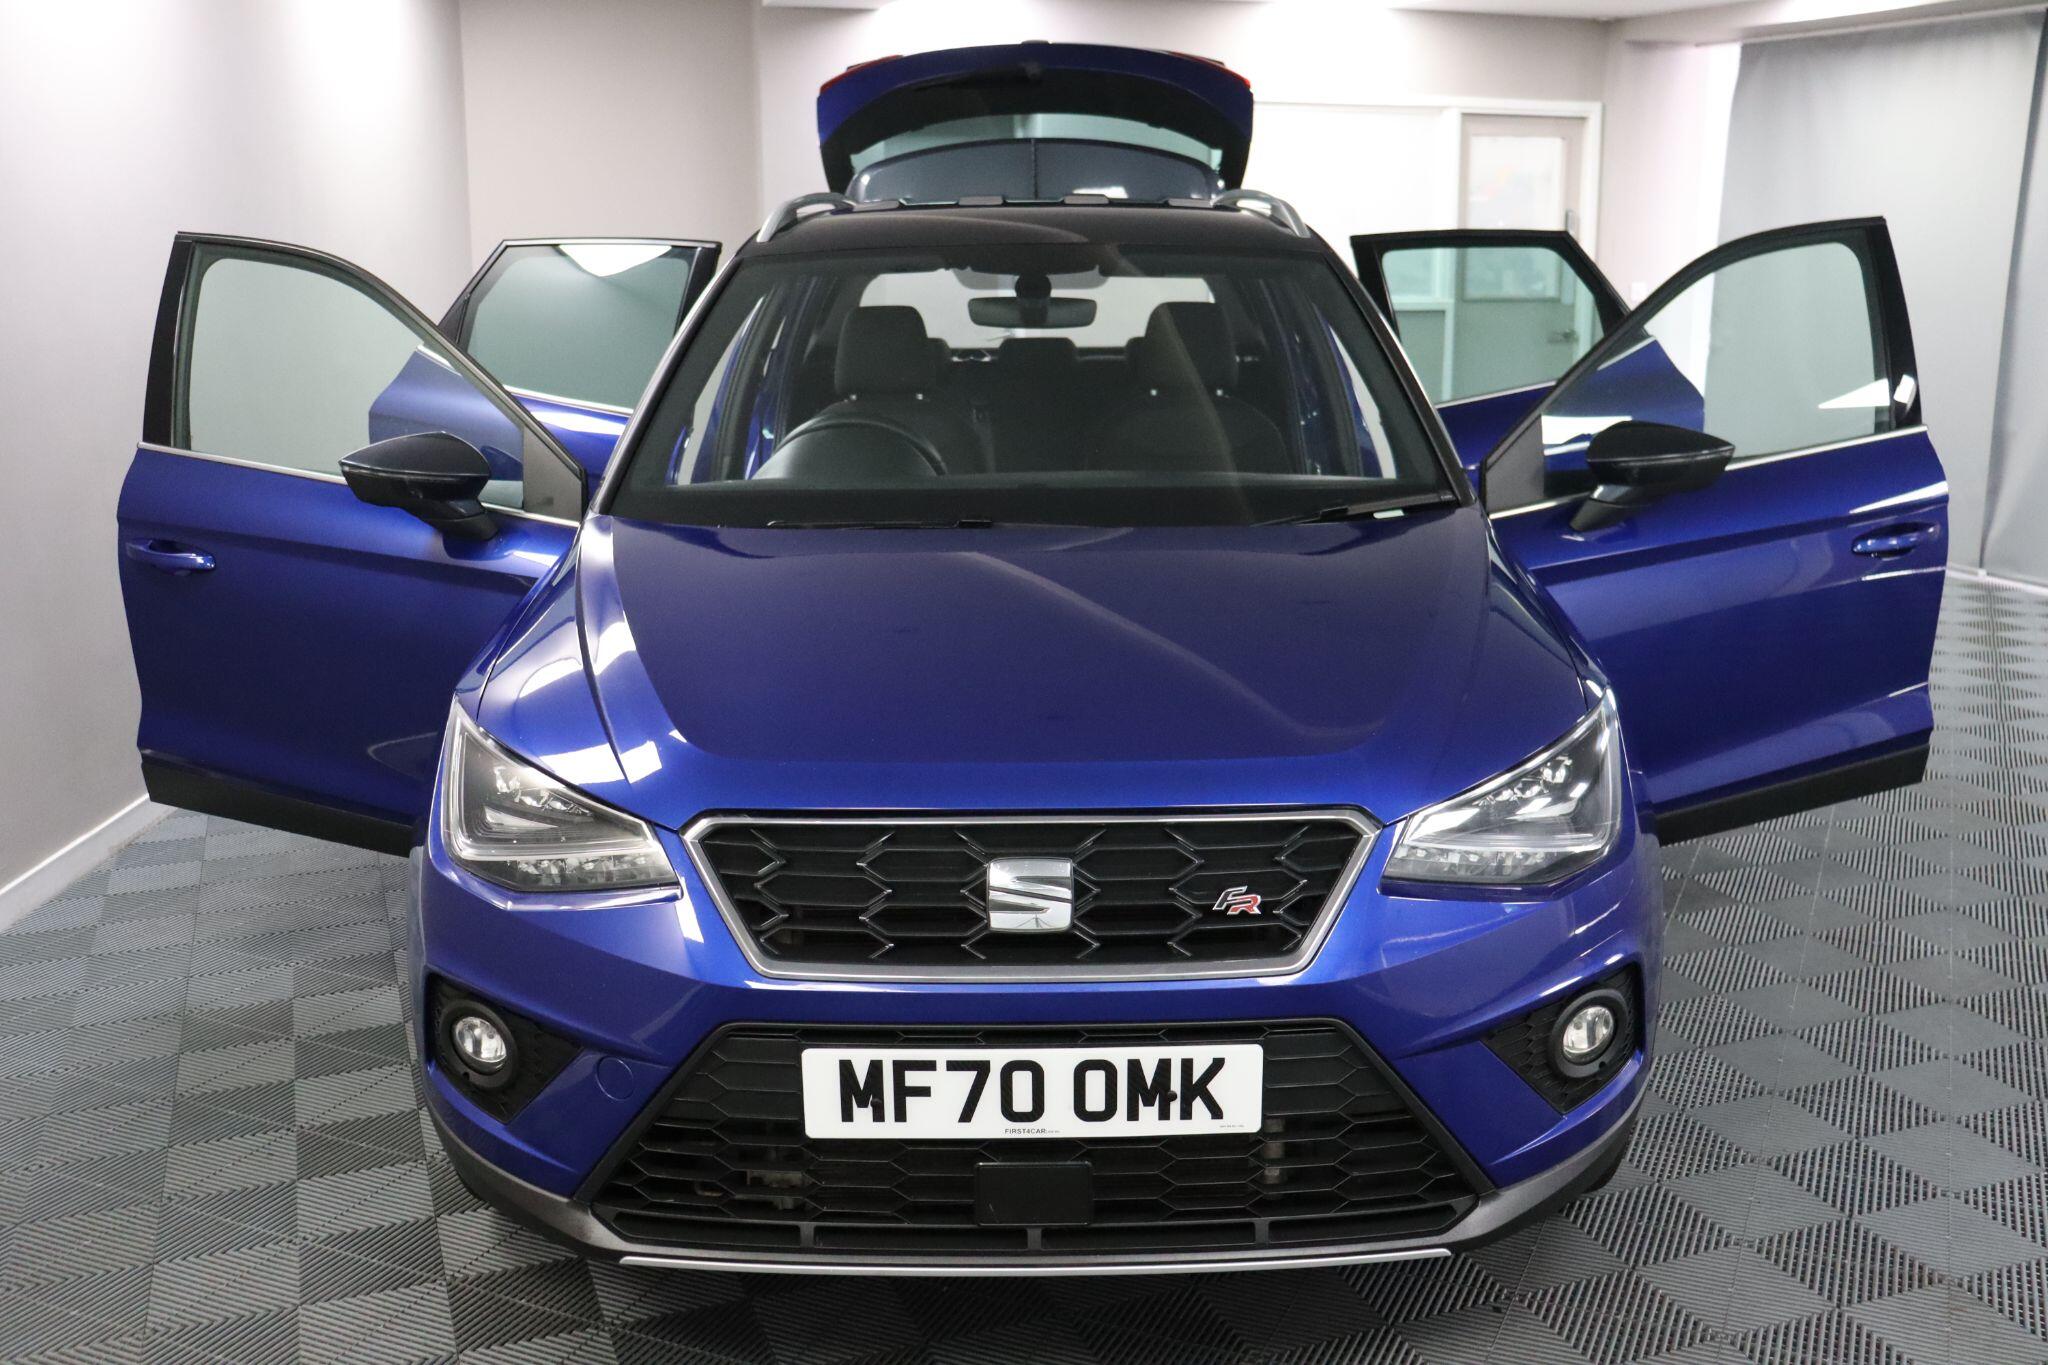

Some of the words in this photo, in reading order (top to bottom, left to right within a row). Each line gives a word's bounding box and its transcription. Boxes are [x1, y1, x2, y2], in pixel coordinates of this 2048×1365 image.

[1212, 885, 1262, 916] FR
[838, 1058, 1046, 1123] MF70
[1073, 1057, 1227, 1122] OMK
